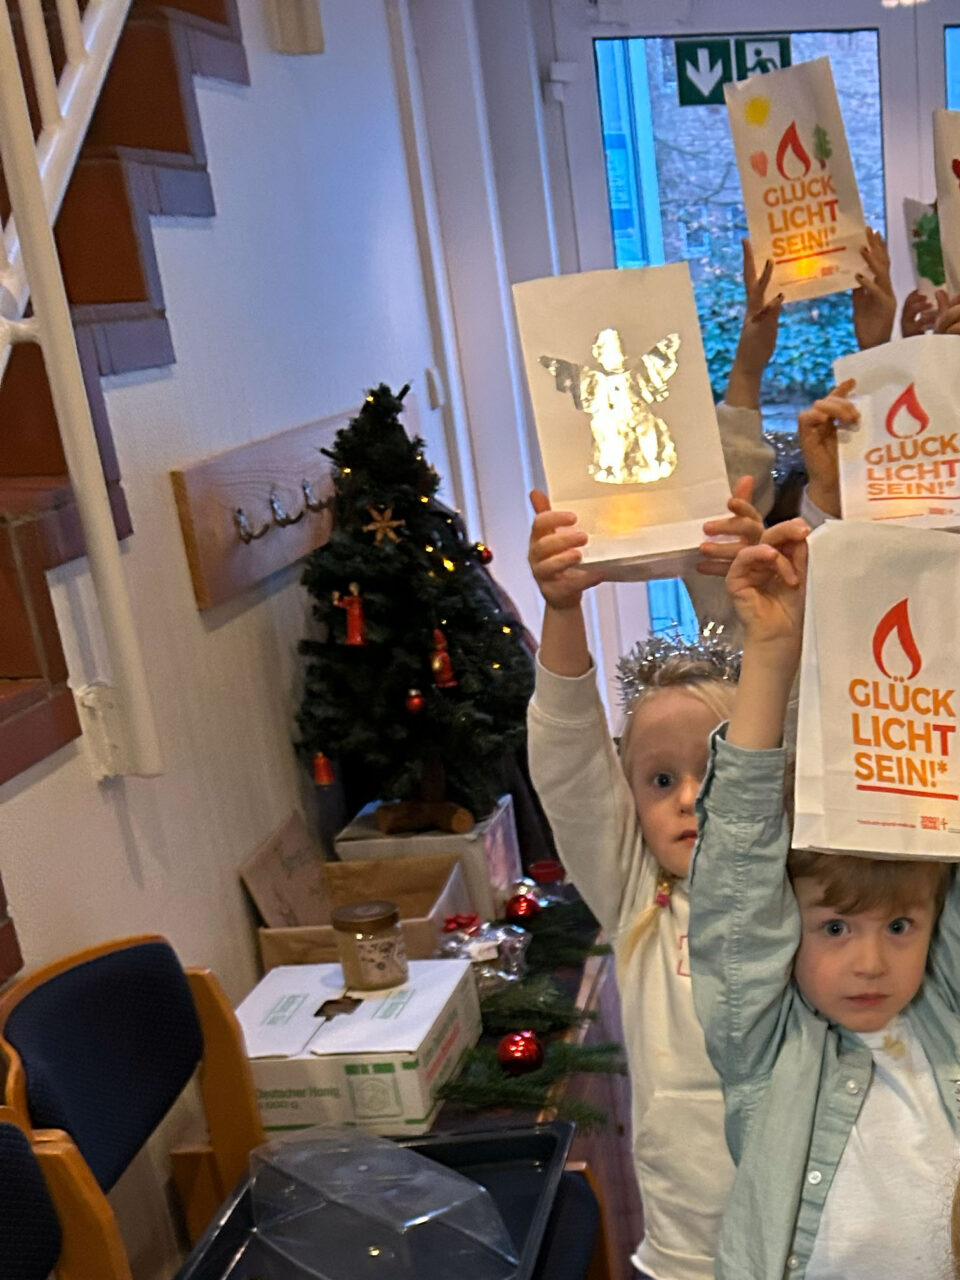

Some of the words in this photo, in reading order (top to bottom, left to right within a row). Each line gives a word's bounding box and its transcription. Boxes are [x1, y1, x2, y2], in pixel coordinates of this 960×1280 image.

[768, 199, 839, 234] LICHT
[848, 675, 957, 718] GLÜCK
[852, 712, 957, 757] LICHT
